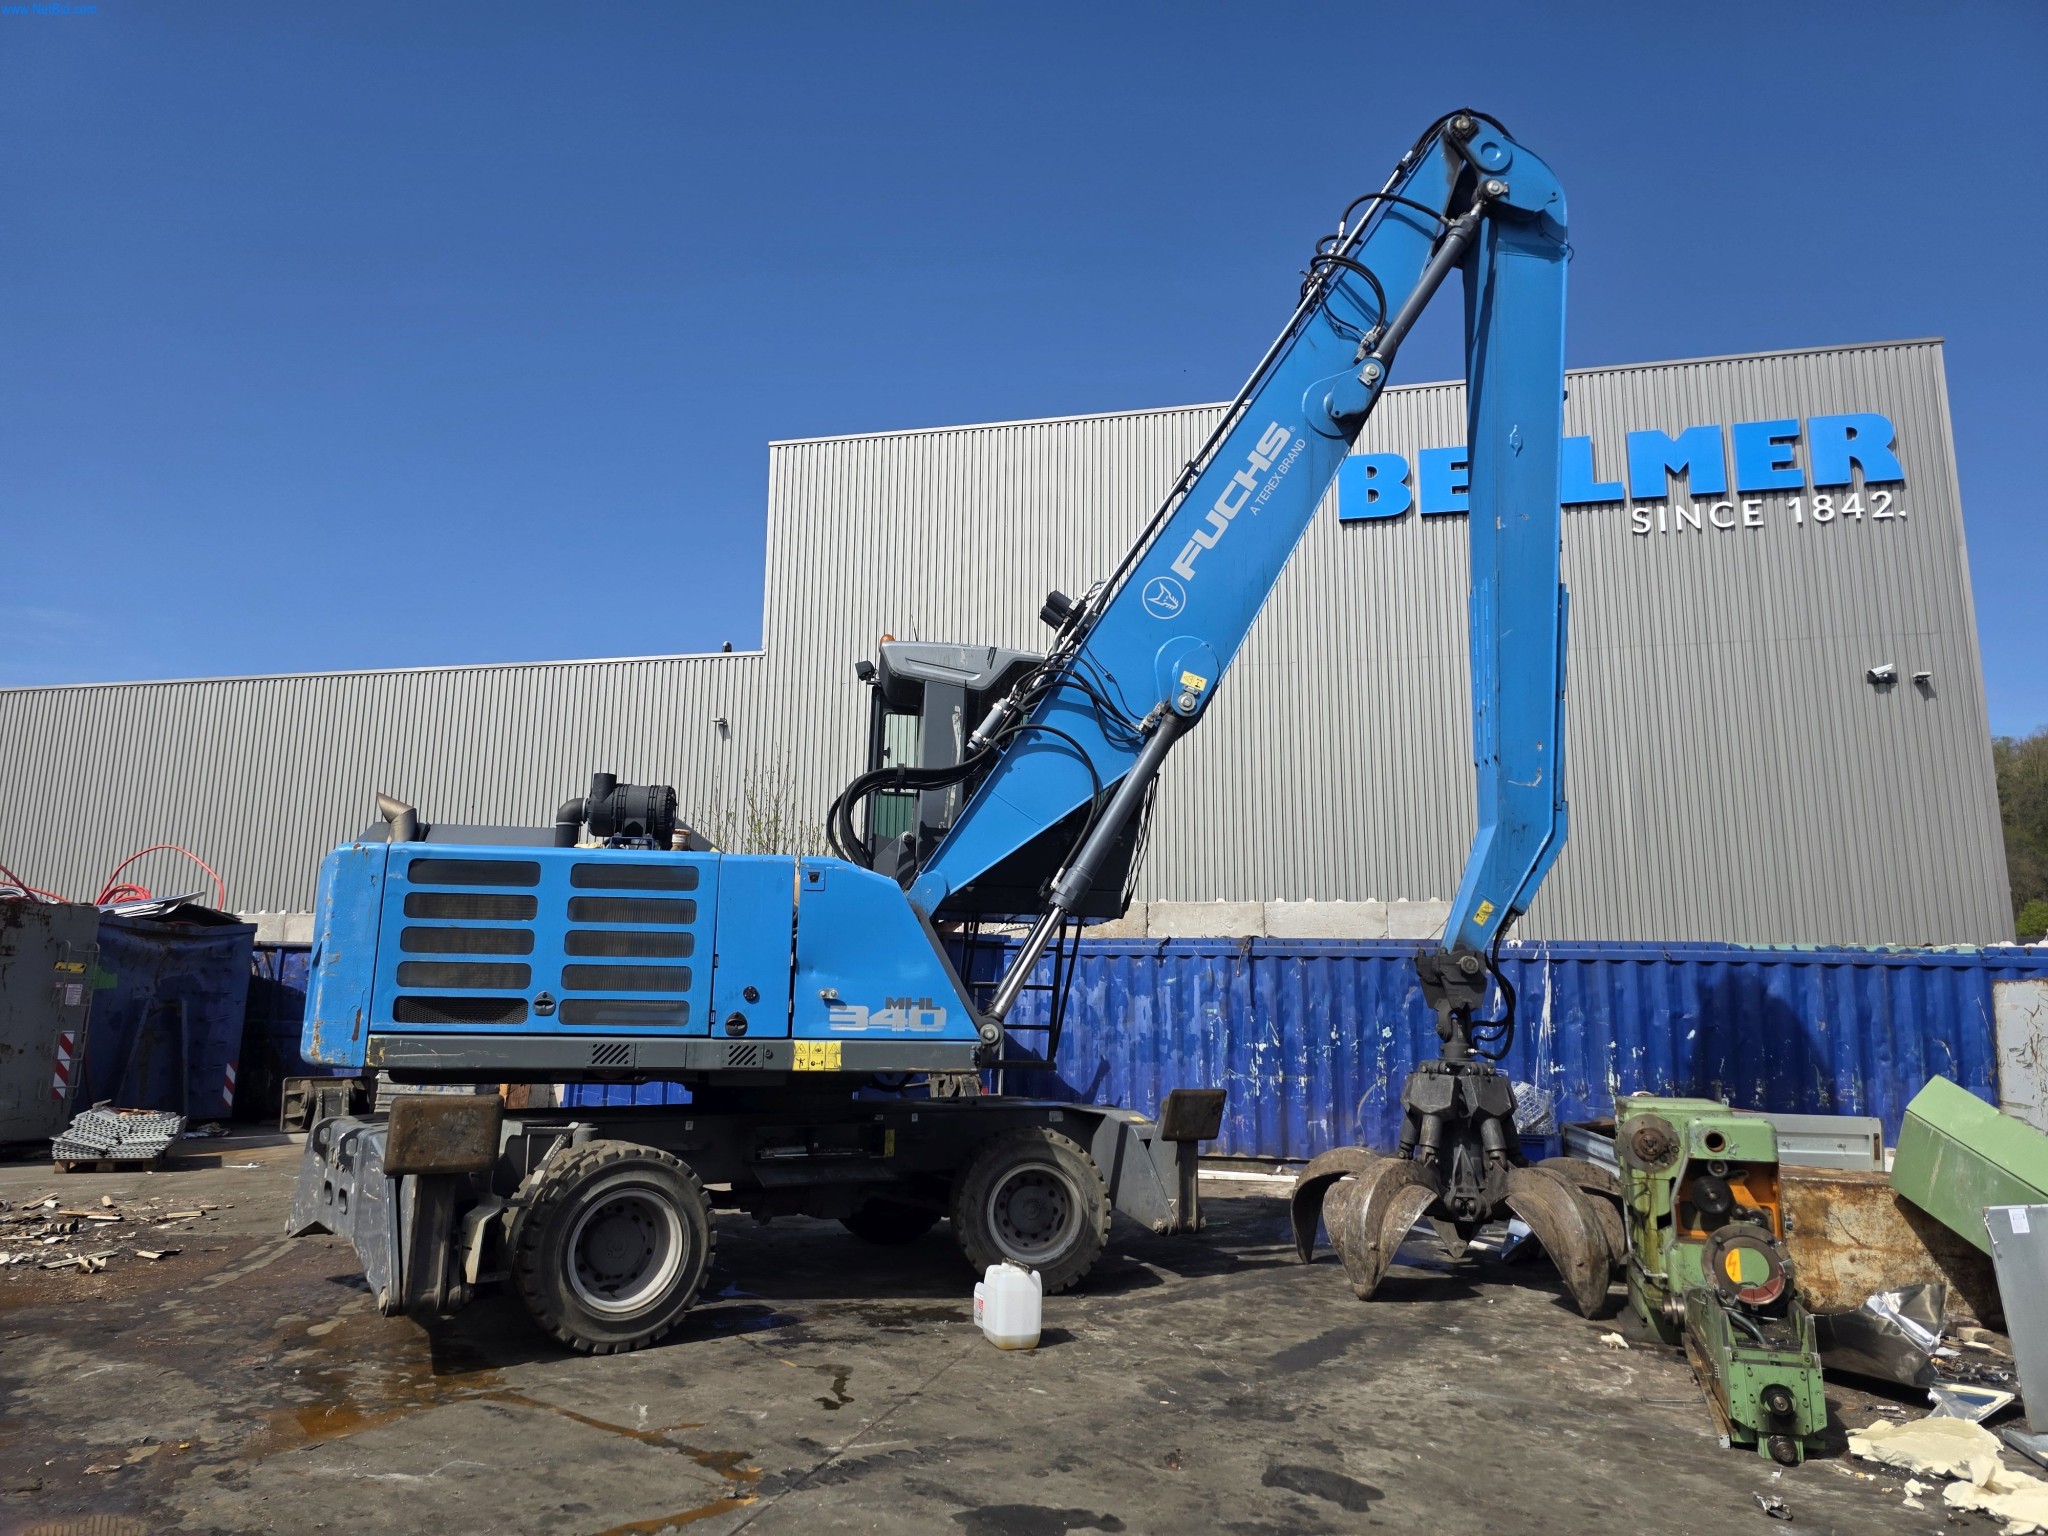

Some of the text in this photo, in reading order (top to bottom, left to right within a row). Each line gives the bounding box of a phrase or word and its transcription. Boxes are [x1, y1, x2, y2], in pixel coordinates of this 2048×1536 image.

[1249, 438, 1306, 516] A TEREX BRAND
[1337, 412, 1904, 520] BELMER
[1632, 491, 1907, 533] SINCE 1842.
[829, 1005, 947, 1032] 340
[885, 997, 942, 1010] MHL
